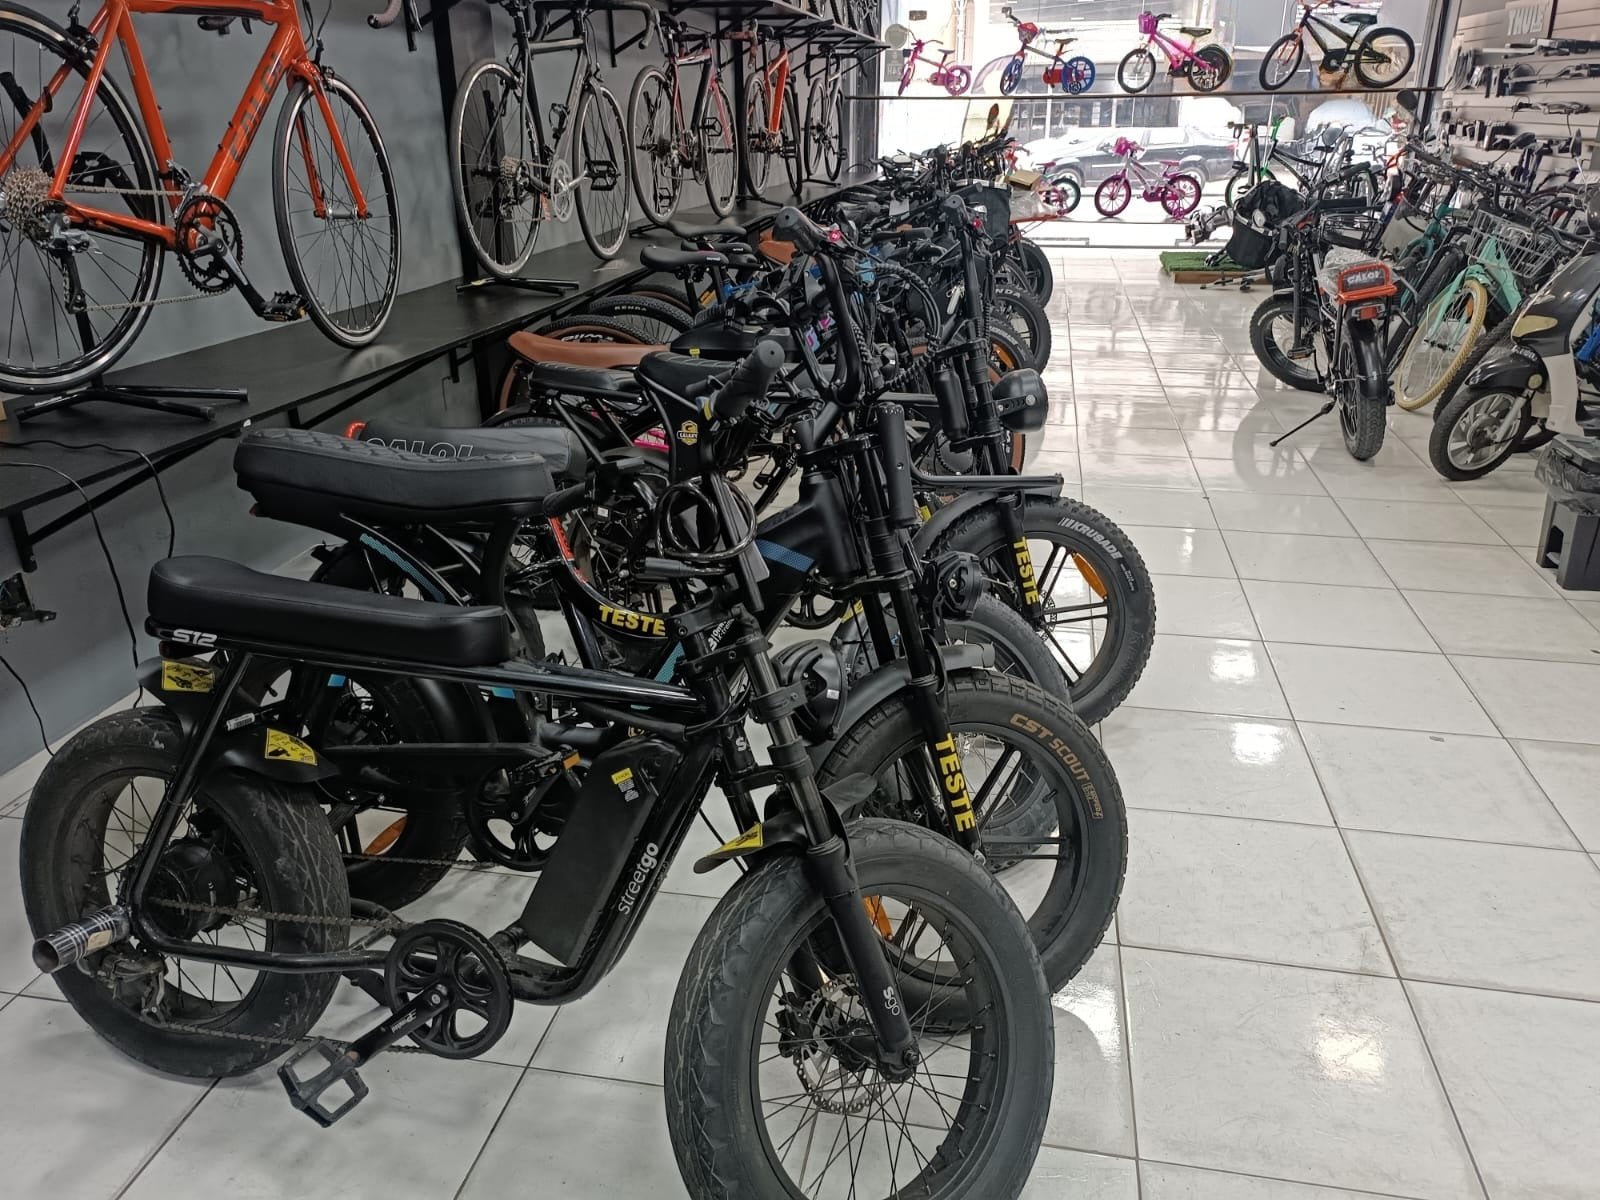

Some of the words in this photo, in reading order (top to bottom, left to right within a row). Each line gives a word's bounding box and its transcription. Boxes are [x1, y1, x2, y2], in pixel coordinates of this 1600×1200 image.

[995, 288, 1021, 298] NDA
[1070, 519, 1122, 560] KRUSADE
[1013, 536, 1041, 606] TESTE
[599, 604, 666, 637] TESTE
[1009, 713, 1053, 739] CST
[1048, 738, 1091, 781] SCOUT
[935, 732, 976, 832] TESTE
[618, 842, 659, 915] streetgo
[883, 985, 901, 1016] sgo
